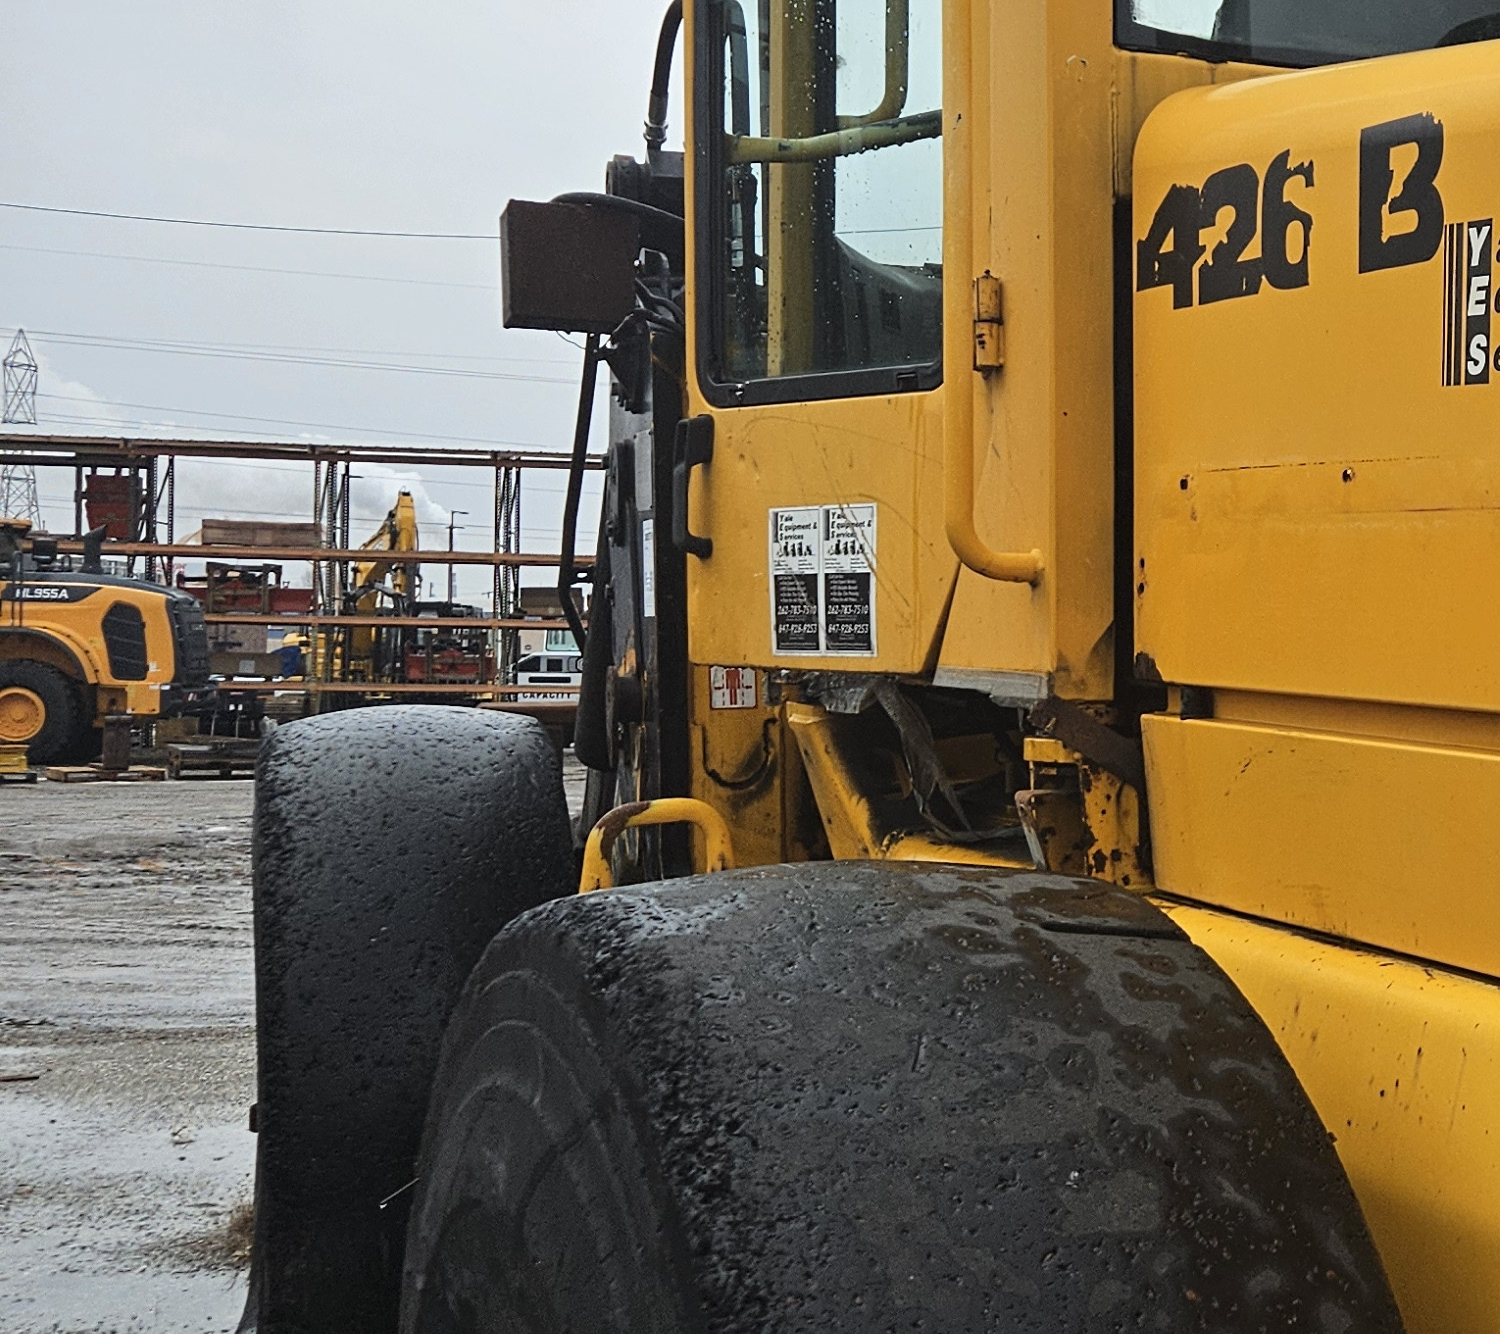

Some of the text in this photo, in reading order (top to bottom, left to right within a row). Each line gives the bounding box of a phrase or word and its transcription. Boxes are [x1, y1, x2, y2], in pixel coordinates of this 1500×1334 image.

[1137, 111, 1444, 310] 426 B
[780, 523, 811, 532] Equipment
[780, 533, 804, 541] Services
[15, 588, 69, 599] HL955A
